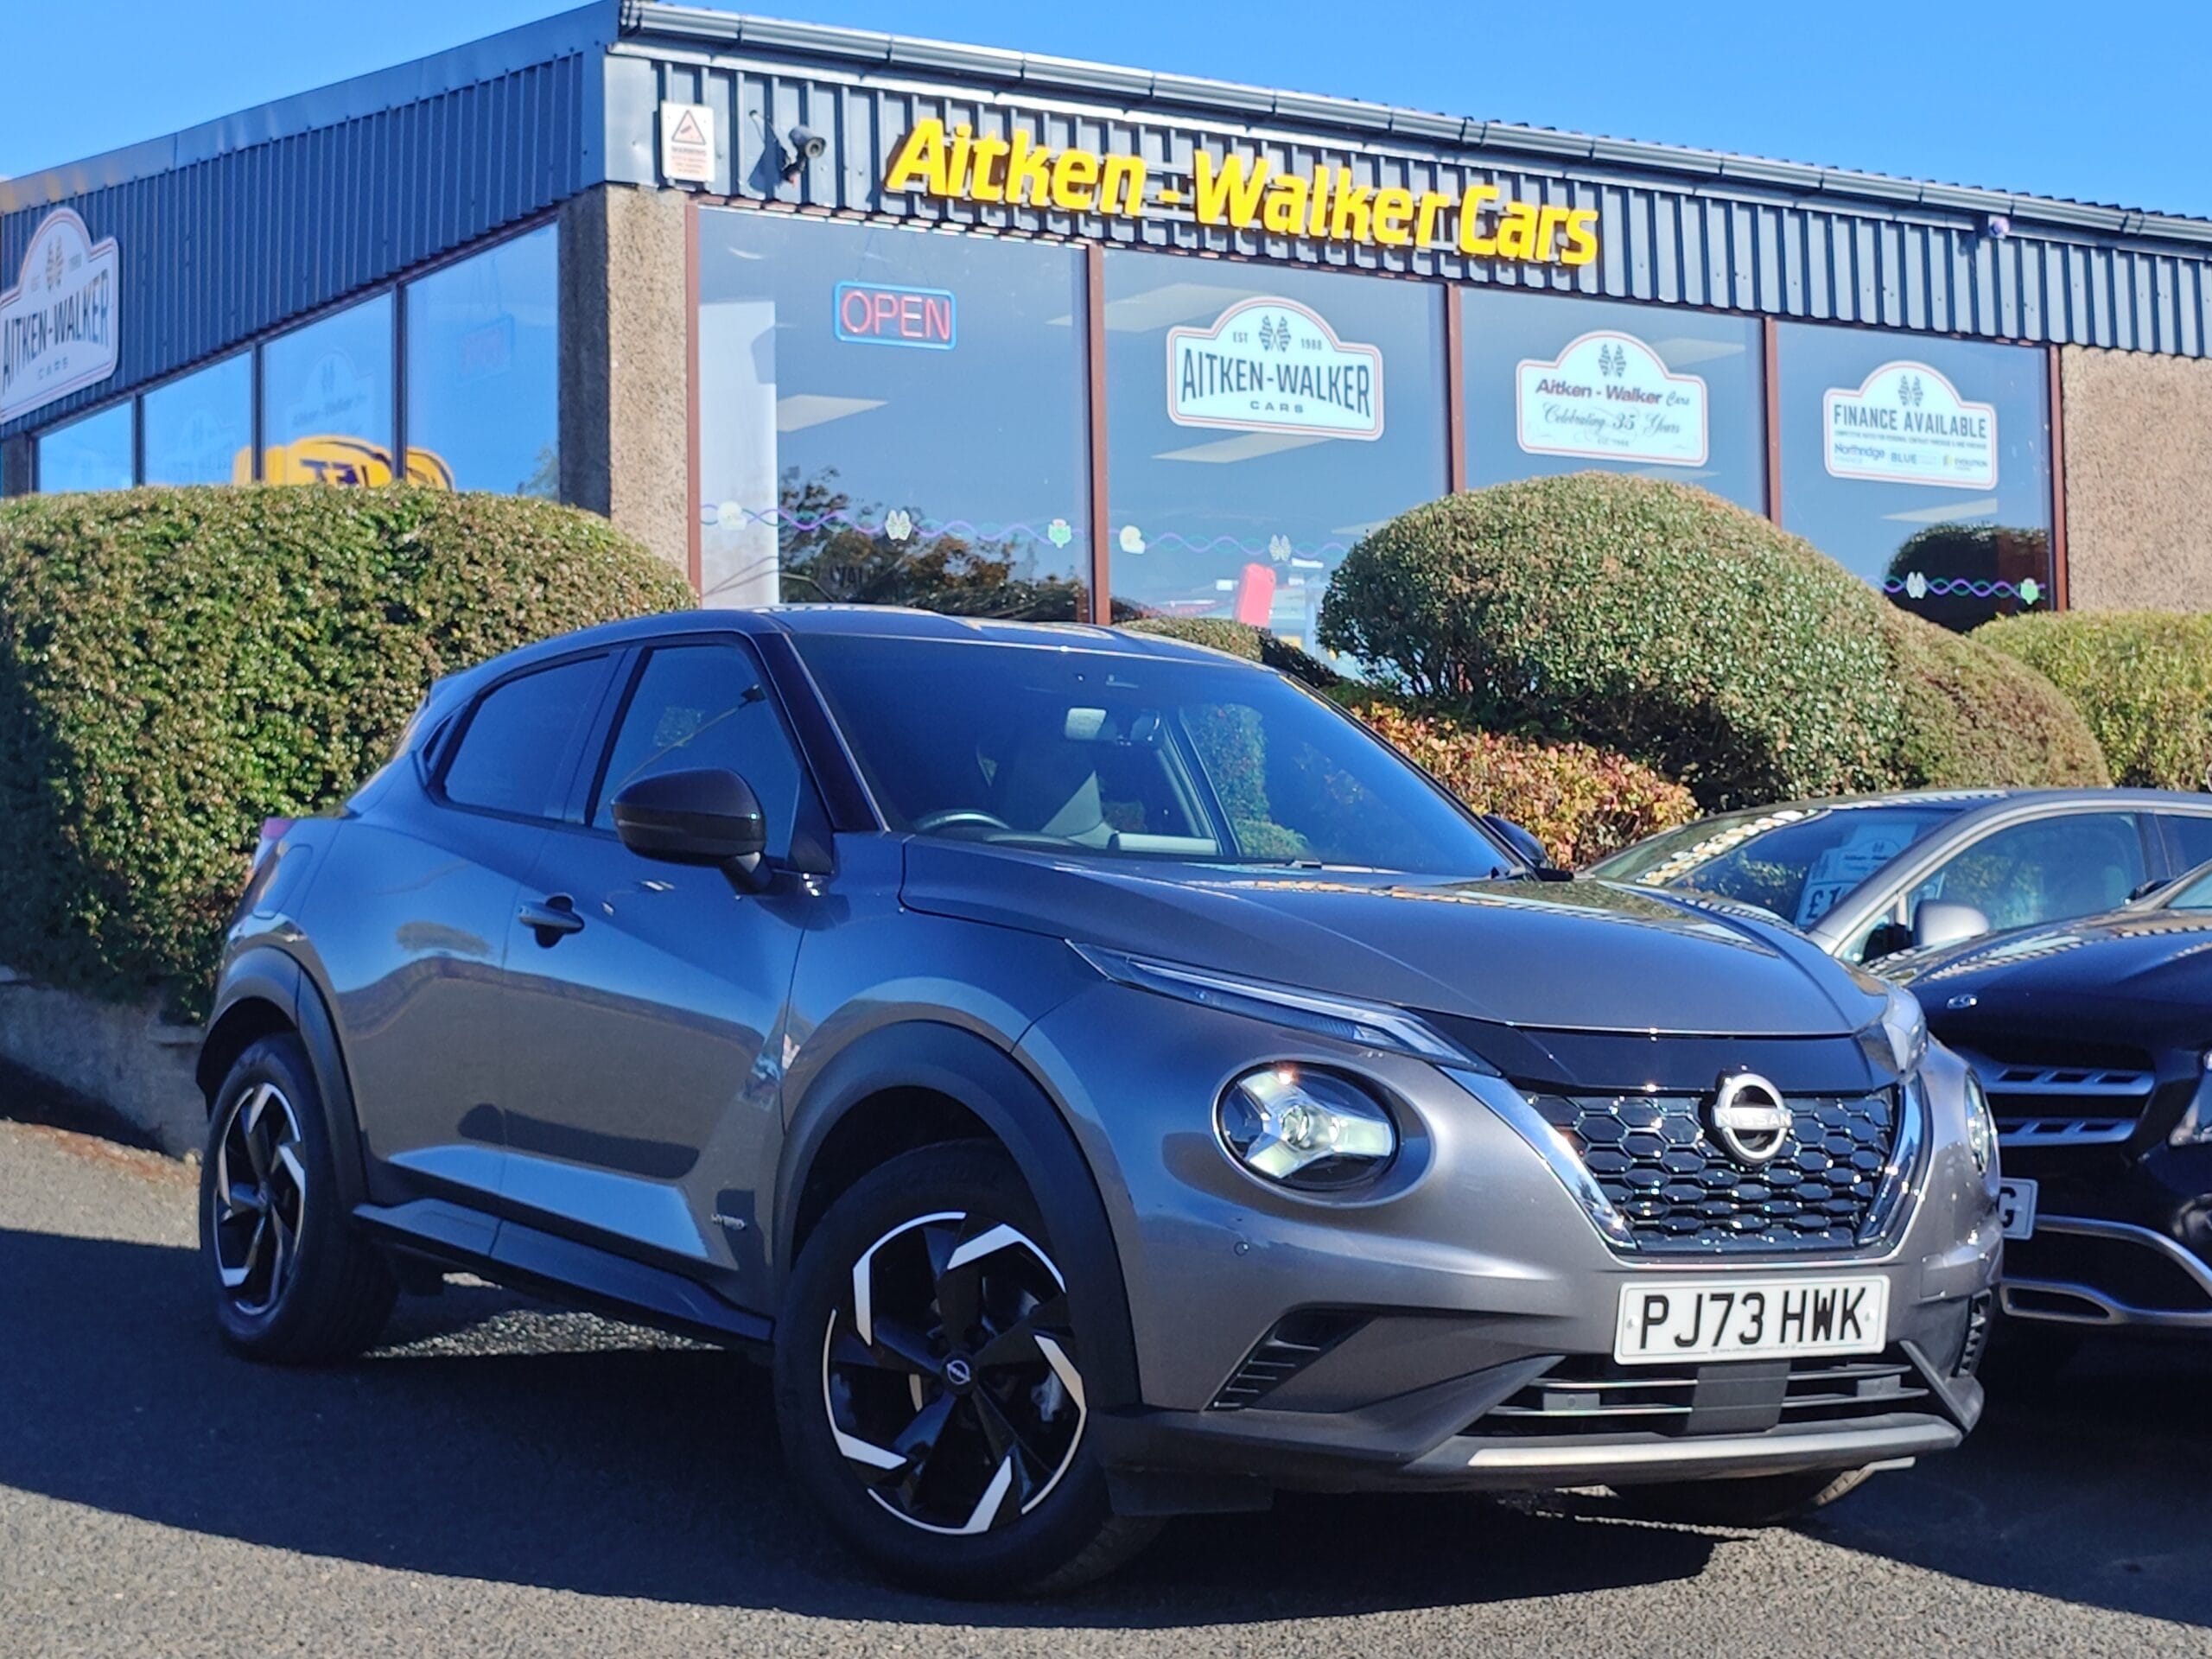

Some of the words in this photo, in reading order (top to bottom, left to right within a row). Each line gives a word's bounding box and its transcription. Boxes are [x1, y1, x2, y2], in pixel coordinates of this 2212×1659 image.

[886, 118, 1146, 216] Aitken
[1195, 150, 1450, 248] Walker
[1459, 185, 1599, 265] Cars
[2, 269, 110, 396] AITKEN-WALKER
[841, 290, 951, 341] OPEN
[1233, 332, 1248, 343] EST
[1182, 348, 1370, 418] AITKEN-WALKER
[1535, 378, 1592, 398] Aitken
[1606, 385, 1663, 404] Walker
[1666, 391, 1691, 407] Cars
[1250, 401, 1303, 413] CARS
[1542, 402, 1606, 429] Celebrating
[1612, 412, 1635, 430] 35
[1643, 413, 1681, 436] Years
[1834, 404, 1897, 430] FINANCE
[1904, 411, 1986, 439] AVAILABLE
[1891, 452, 1917, 465] BLUE
[1719, 1110, 1791, 1127] NISSAN
[1641, 1292, 1765, 1350] PJ73
[1779, 1287, 1867, 1344] HWK
